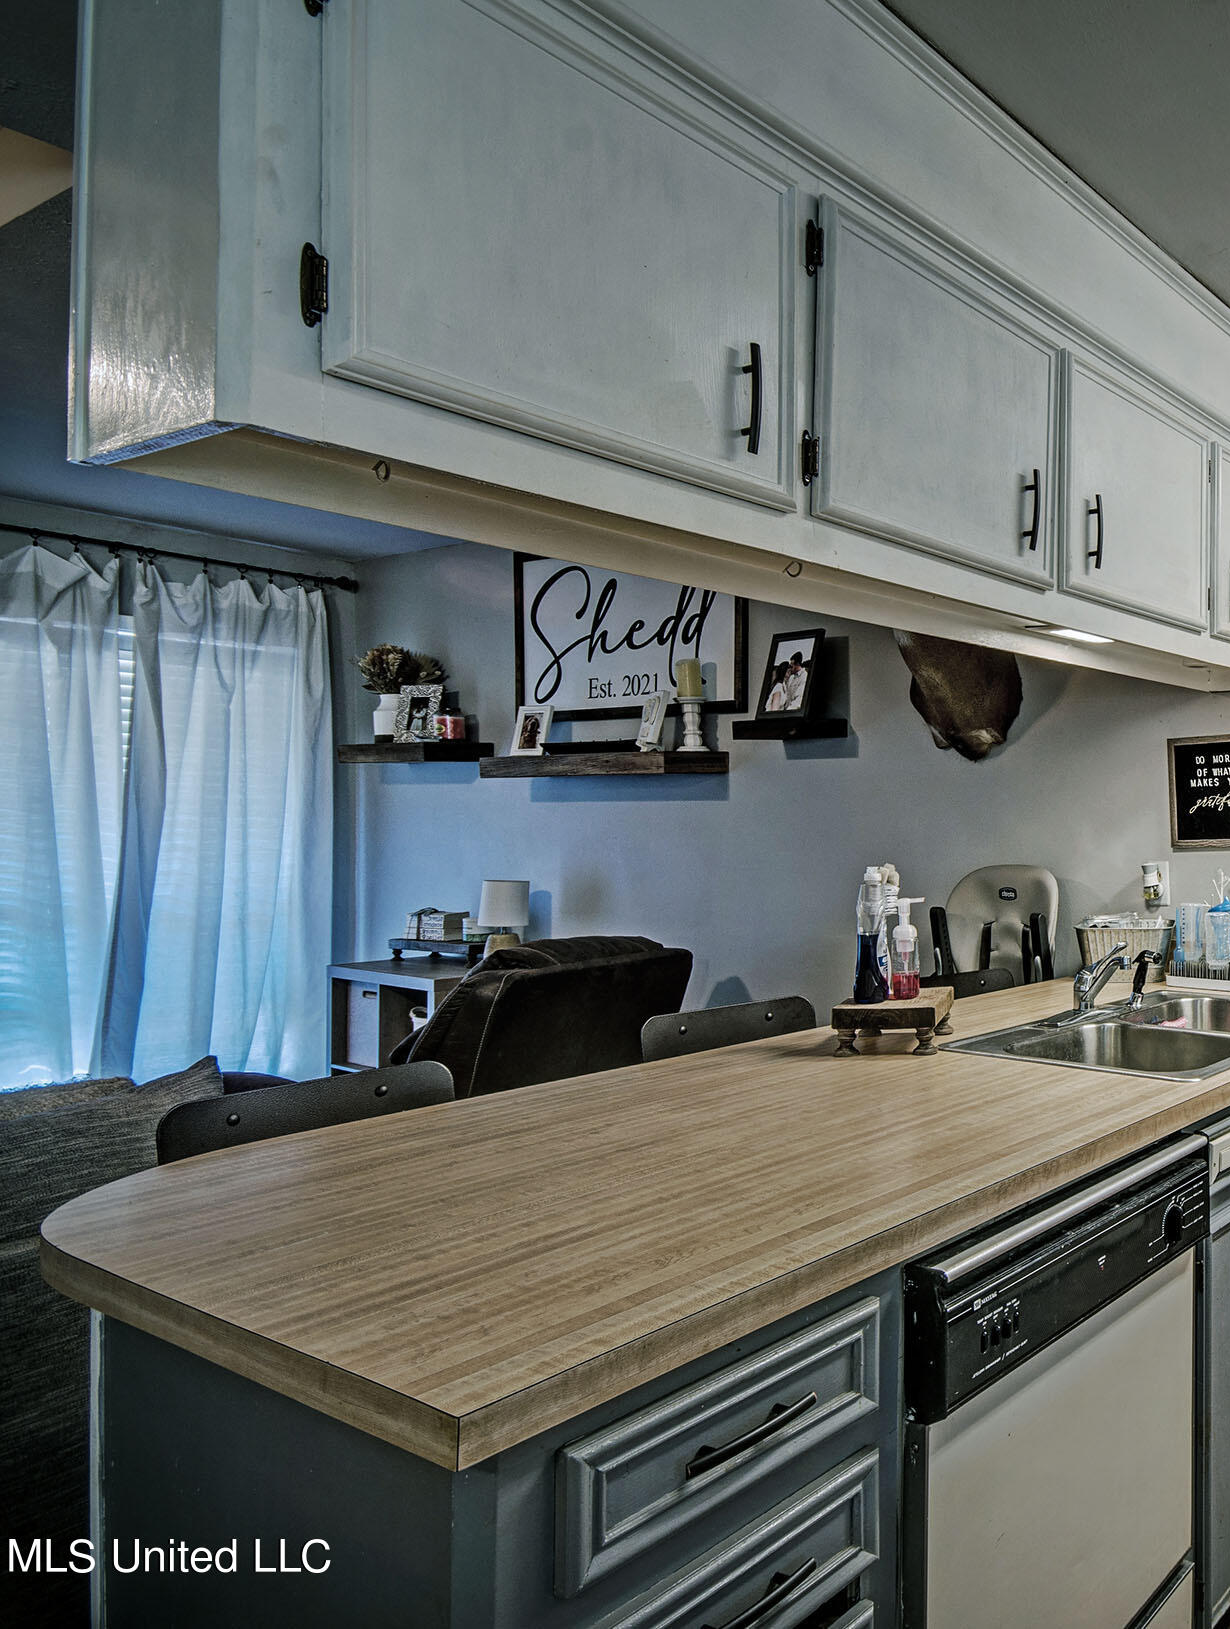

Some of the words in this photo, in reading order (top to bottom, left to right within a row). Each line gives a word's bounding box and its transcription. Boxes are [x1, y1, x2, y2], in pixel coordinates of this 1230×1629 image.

[530, 565, 717, 704] Shedd
[588, 677, 616, 699] Est.
[622, 672, 659, 697] 2021
[1195, 755, 1205, 765] DO
[1196, 768, 1208, 777] OF
[1190, 778, 1220, 788] MAKES
